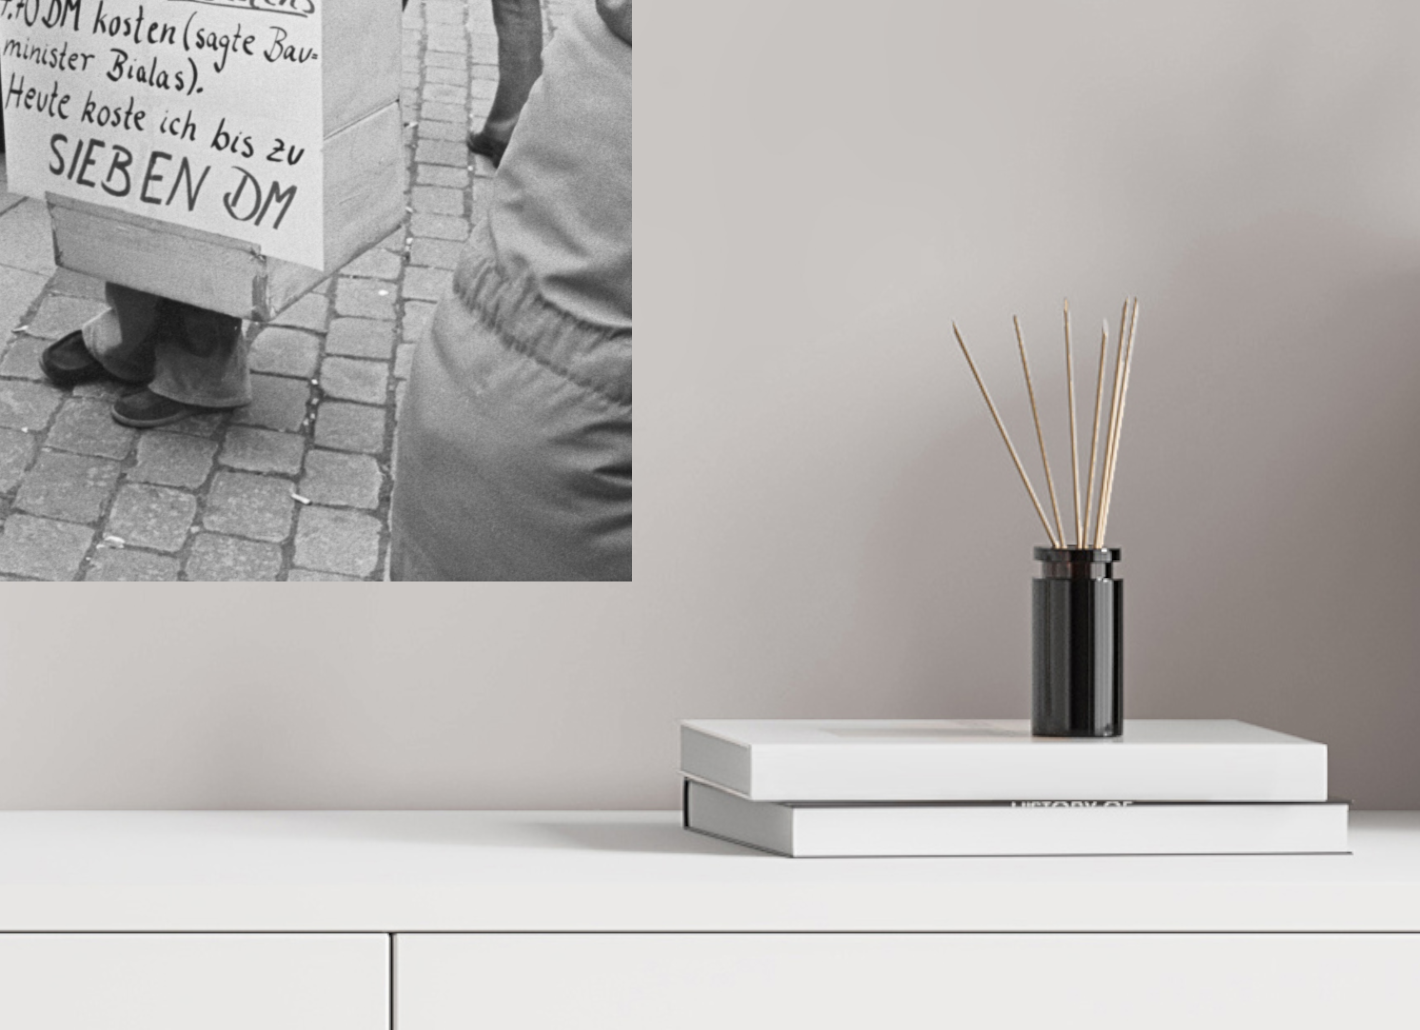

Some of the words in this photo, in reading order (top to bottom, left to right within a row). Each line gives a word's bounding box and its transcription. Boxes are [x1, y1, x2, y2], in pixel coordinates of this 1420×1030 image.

[3, 38, 96, 72] minister
[106, 47, 205, 97] Bialas).
[93, 0, 177, 46] kosten
[182, 10, 256, 74] (sagte
[4, 72, 71, 121] Heute
[81, 90, 147, 132] koste
[159, 109, 198, 142] ich
[210, 117, 255, 159] bis
[265, 137, 306, 167] zu
[48, 132, 212, 212] SIEBEN
[222, 165, 298, 231] DM
